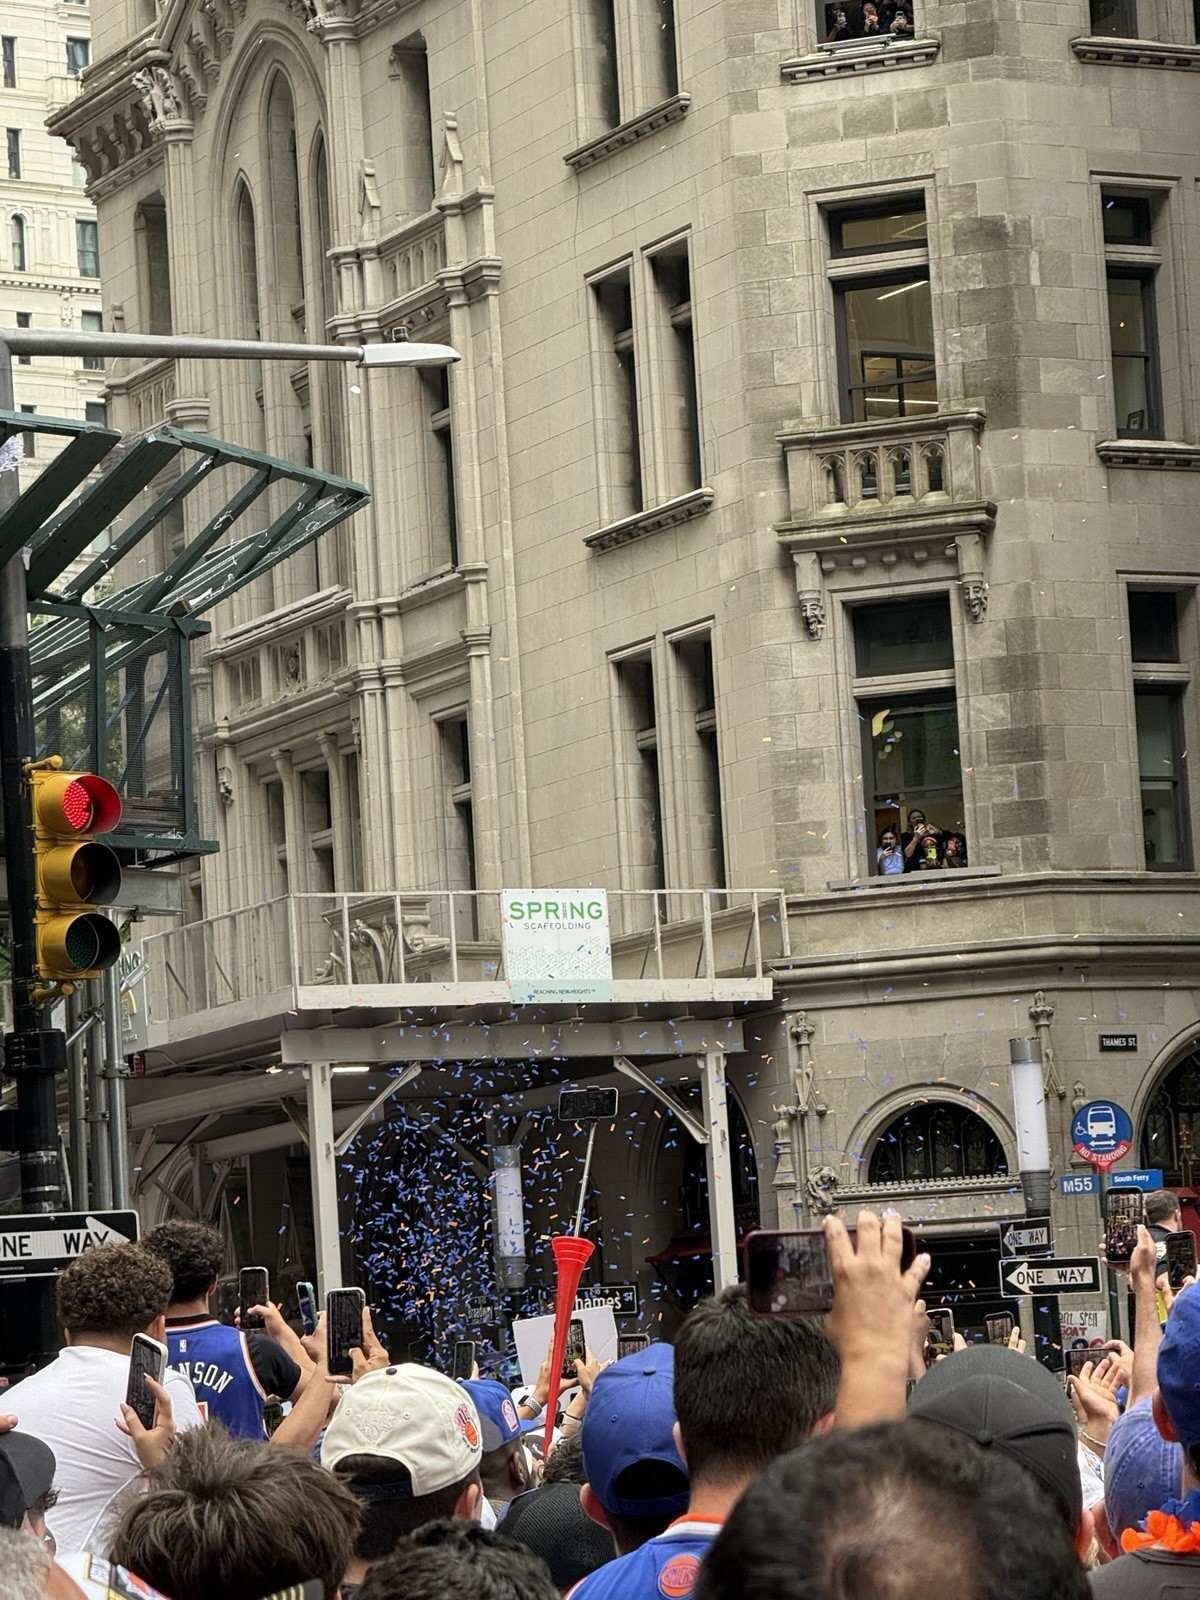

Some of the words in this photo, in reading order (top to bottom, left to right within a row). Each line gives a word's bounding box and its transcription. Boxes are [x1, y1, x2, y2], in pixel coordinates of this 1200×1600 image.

[509, 901, 603, 920] SPRING
[523, 922, 591, 930] SCAFFOLDING
[1102, 1037, 1127, 1046] THAMES
[1080, 1146, 1091, 1158] NO
[1091, 1145, 1128, 1161] STANDING
[1063, 1177, 1093, 1193] M55
[1114, 1174, 1132, 1183] South
[1133, 1173, 1149, 1182] Ferry
[0, 1234, 32, 1257] NE
[63, 1230, 109, 1254] WAY
[1008, 1232, 1022, 1246] ONE
[1029, 1229, 1044, 1244] WAY
[1017, 1270, 1044, 1285] ONE
[1057, 1268, 1086, 1283] WAY
[575, 1294, 621, 1310] hames
[167, 1361, 233, 1394] NSON
